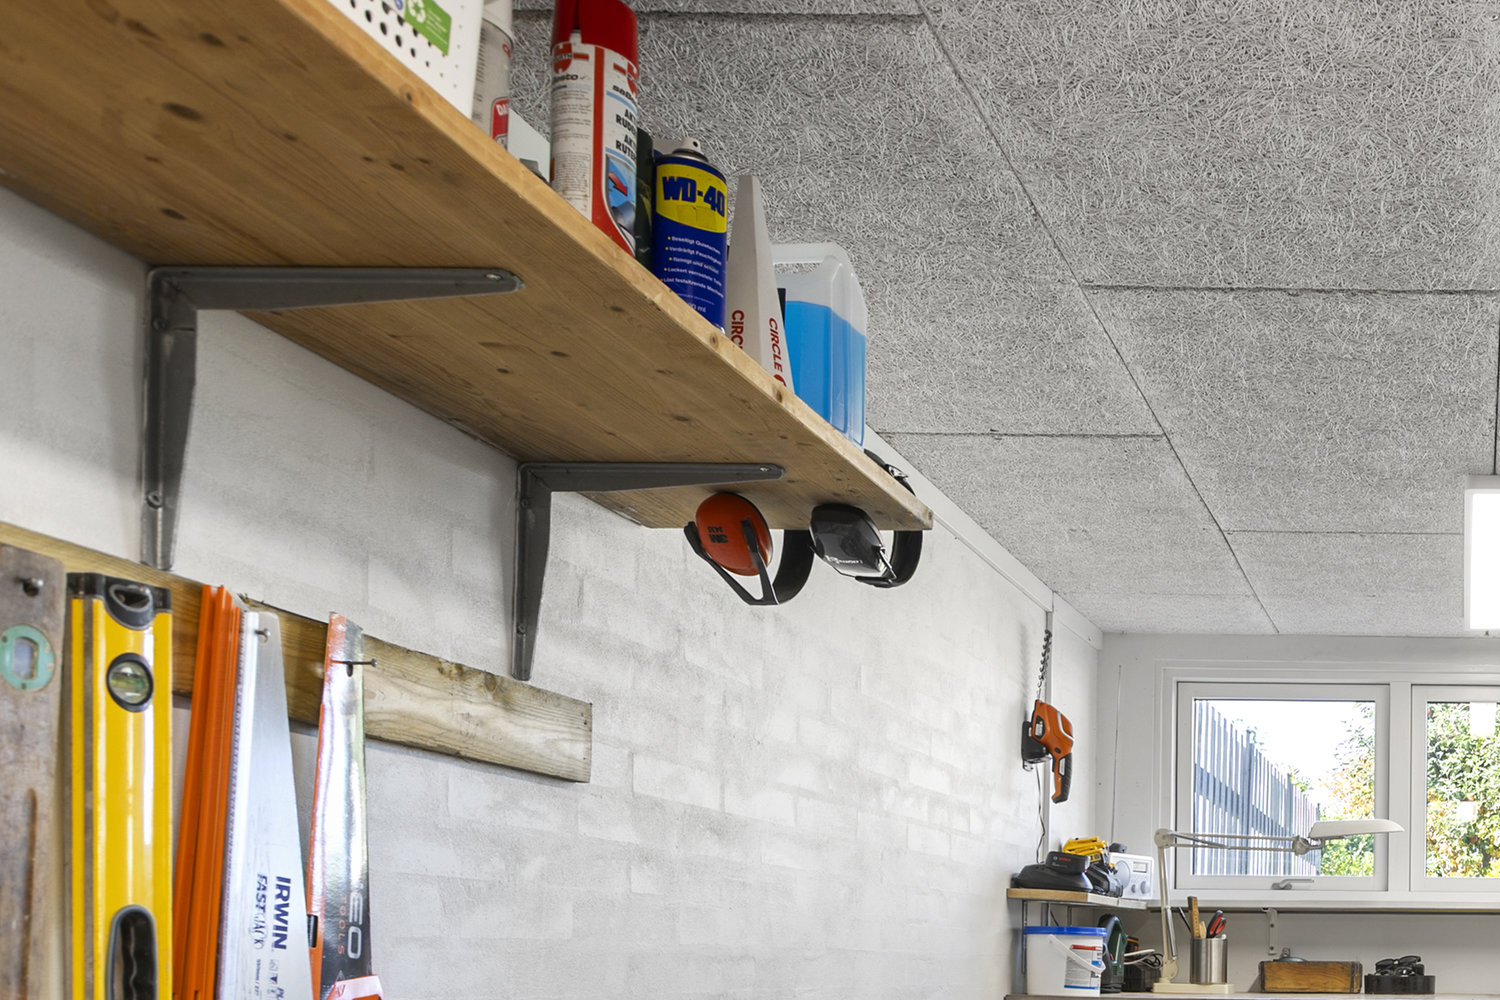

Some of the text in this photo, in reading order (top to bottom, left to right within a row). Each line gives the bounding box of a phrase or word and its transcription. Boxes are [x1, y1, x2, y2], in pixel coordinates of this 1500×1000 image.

[662, 176, 725, 218] WD-40
[731, 309, 745, 350] CIRC
[768, 317, 783, 373] CIRCLE
[255, 873, 268, 914] FAST
[272, 876, 292, 950] IRWIN
[337, 896, 348, 955] TOOLS
